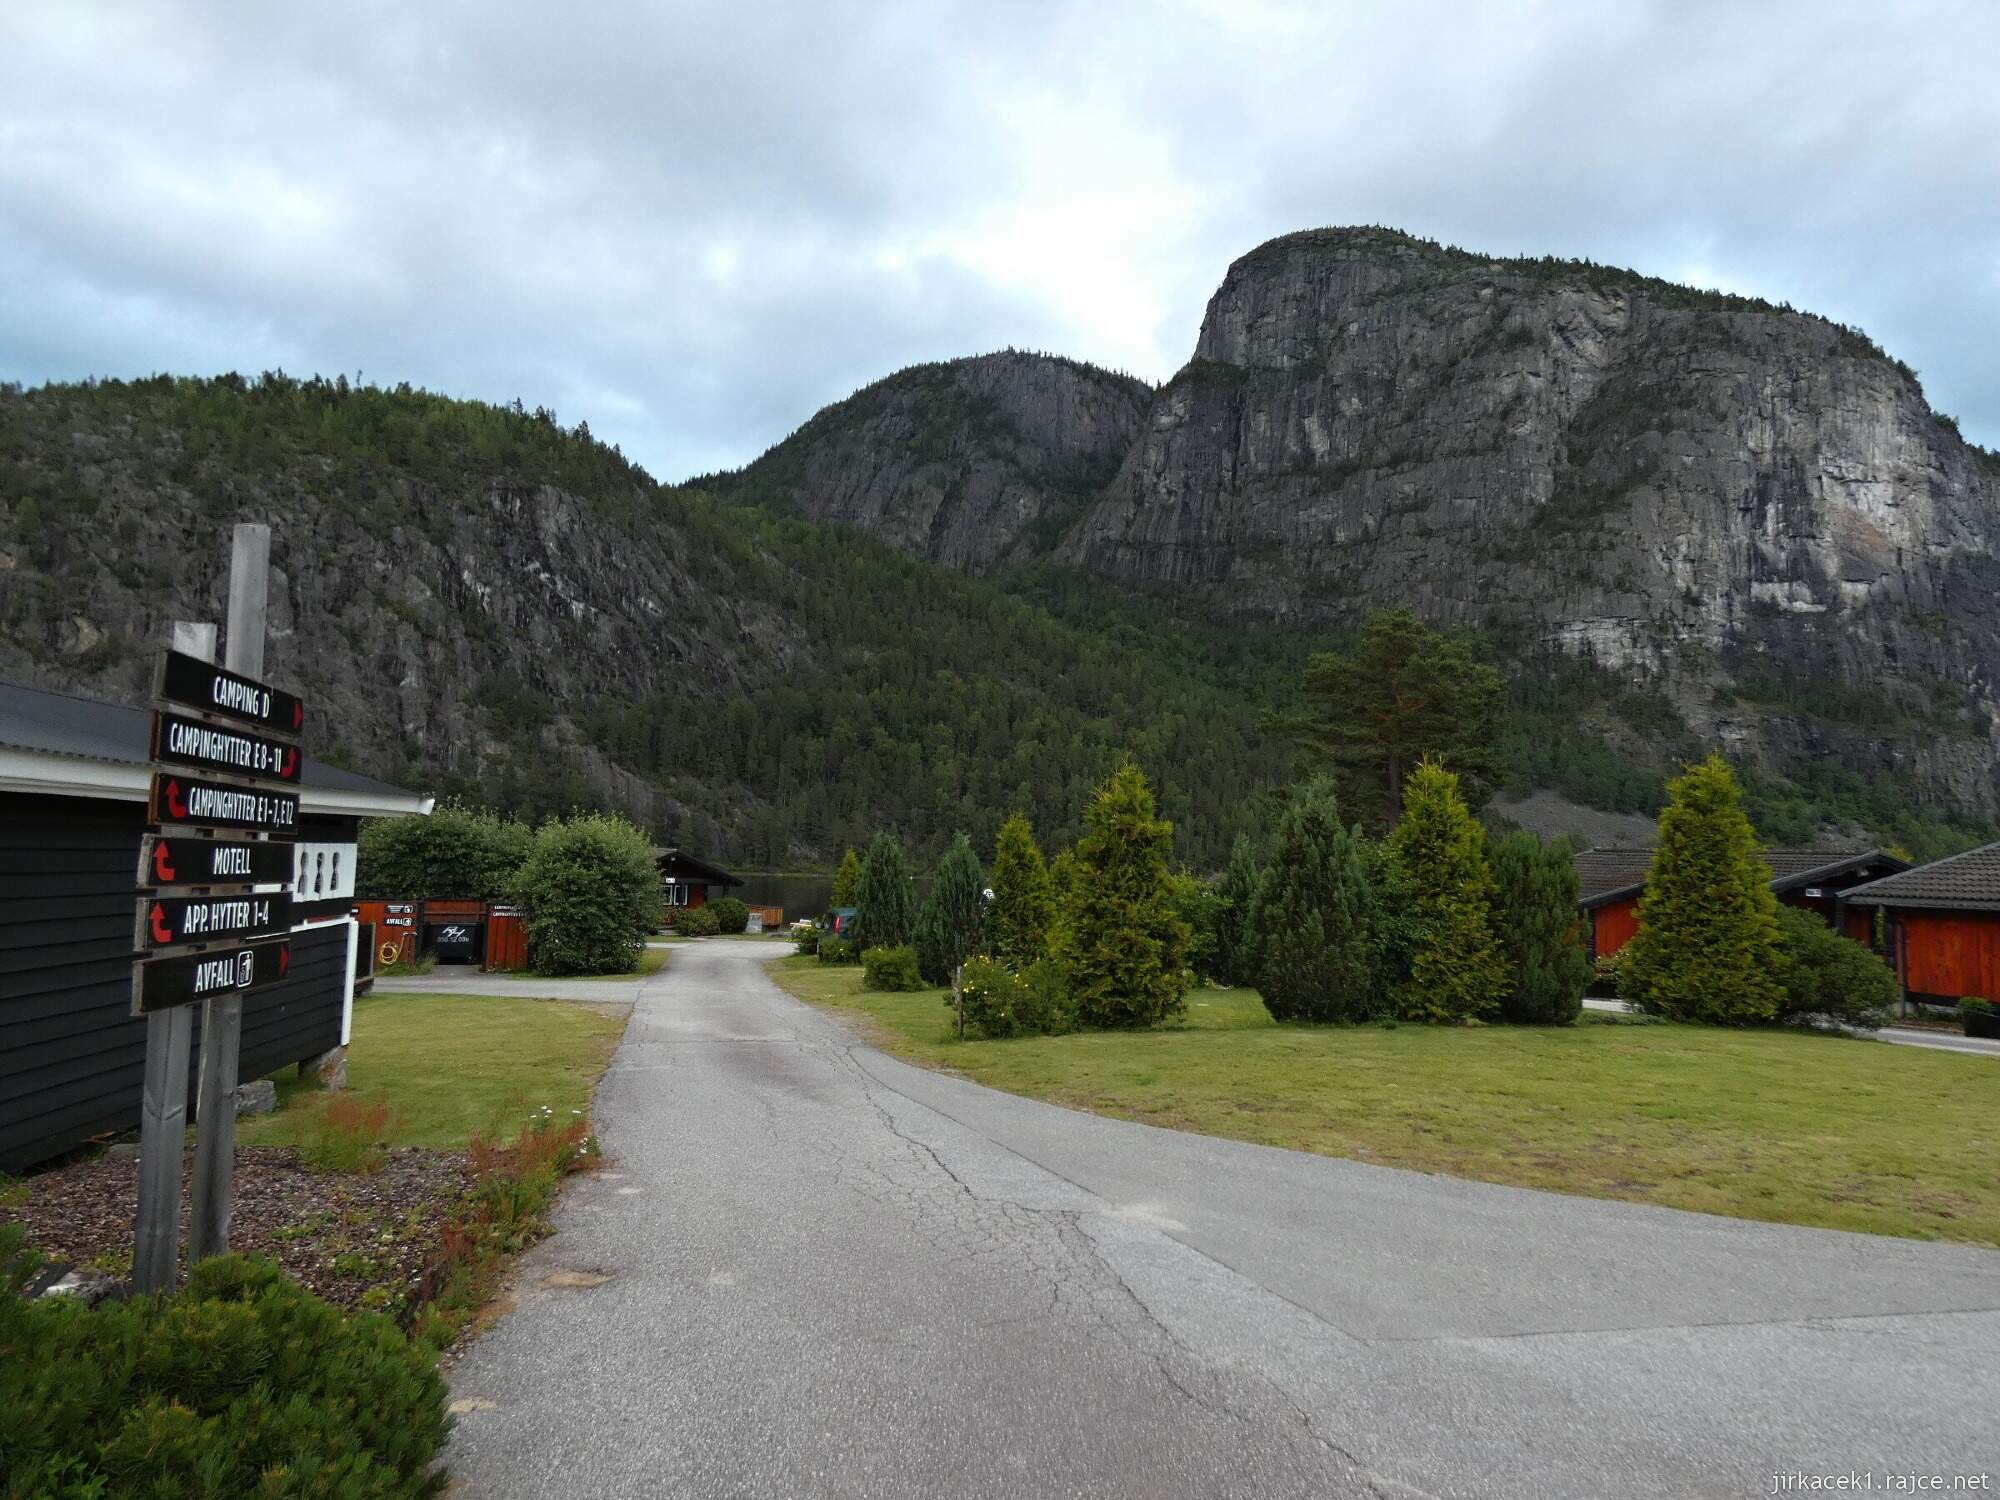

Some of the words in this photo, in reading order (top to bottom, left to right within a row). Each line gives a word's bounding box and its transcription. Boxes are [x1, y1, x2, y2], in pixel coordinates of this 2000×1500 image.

[213, 676, 259, 715] CAMPING
[262, 692, 270, 718] D
[170, 722, 251, 767] CAMPINGHYTTER
[188, 786, 256, 822] CAMPINGHYTTER
[213, 847, 251, 875] MOTELL
[183, 904, 209, 934] APP.
[210, 901, 250, 931] HYTTER
[253, 900, 269, 927] 1-4
[194, 958, 234, 993] AVFALL
